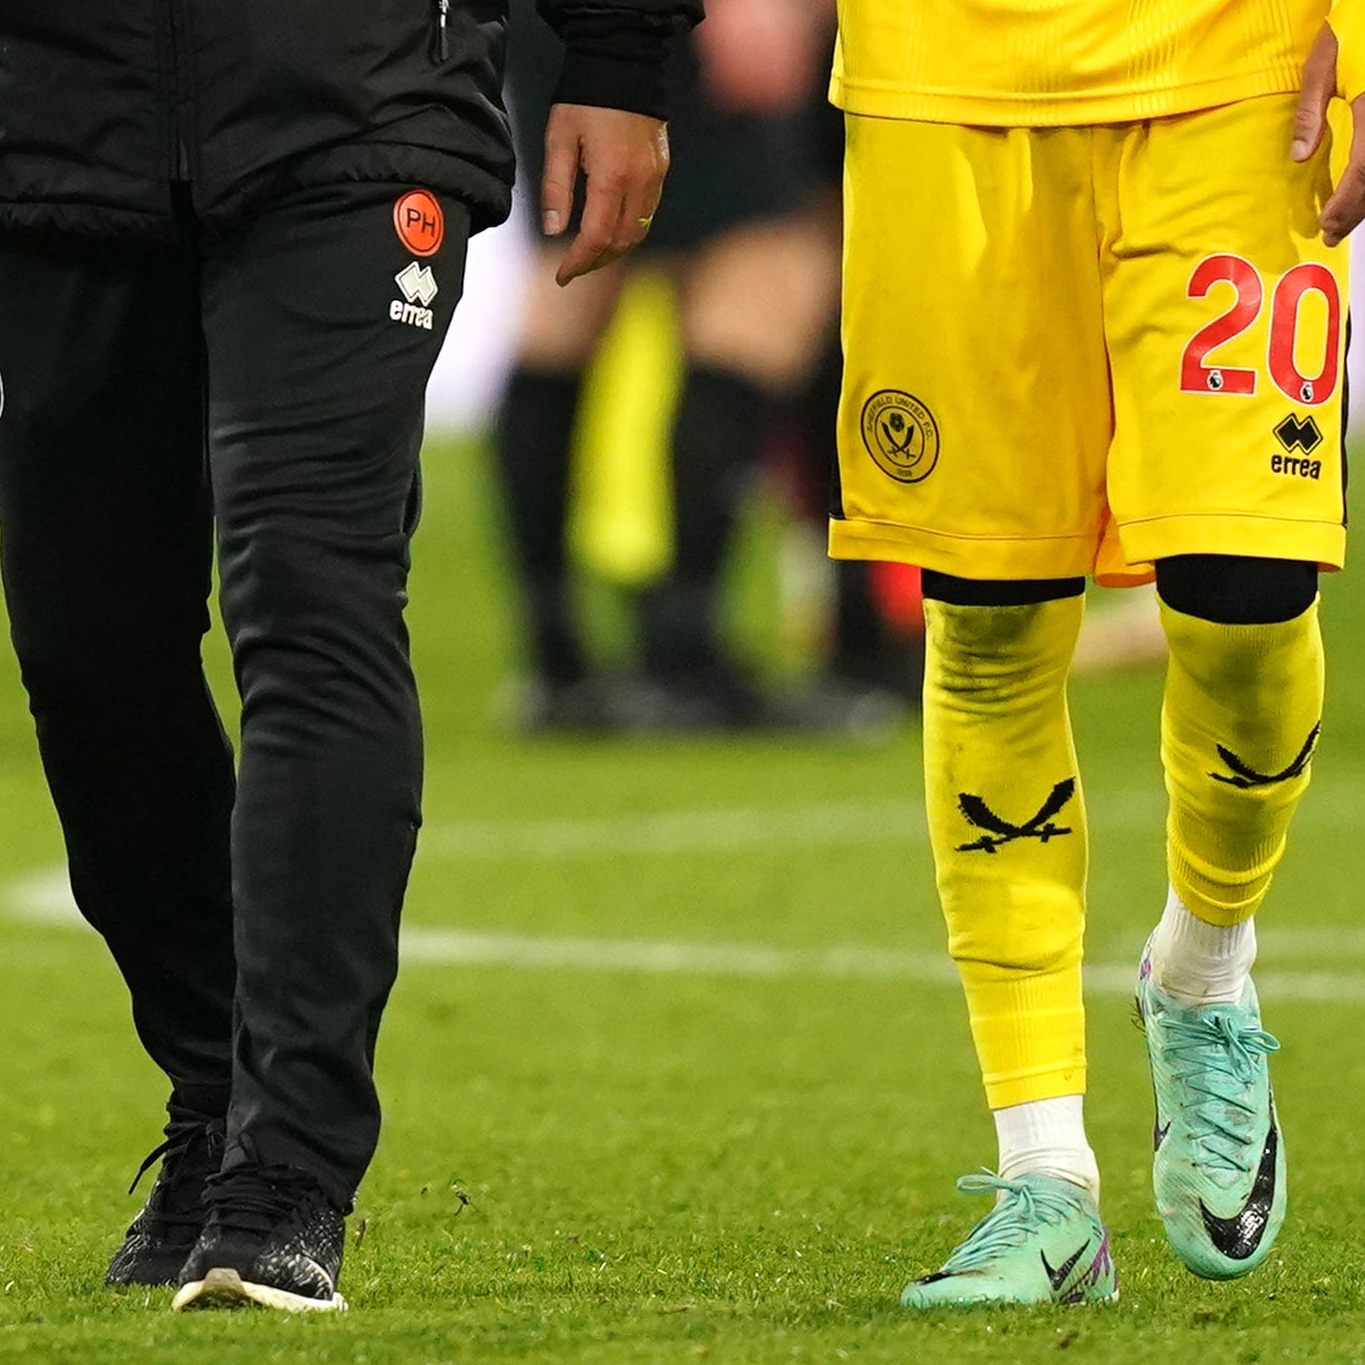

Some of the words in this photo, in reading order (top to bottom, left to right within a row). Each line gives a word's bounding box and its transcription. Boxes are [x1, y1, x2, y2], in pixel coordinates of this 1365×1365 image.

[406, 207, 436, 238] PH
[389, 300, 434, 330] errea
[1179, 252, 1341, 407] 20
[1271, 455, 1322, 480] errea
